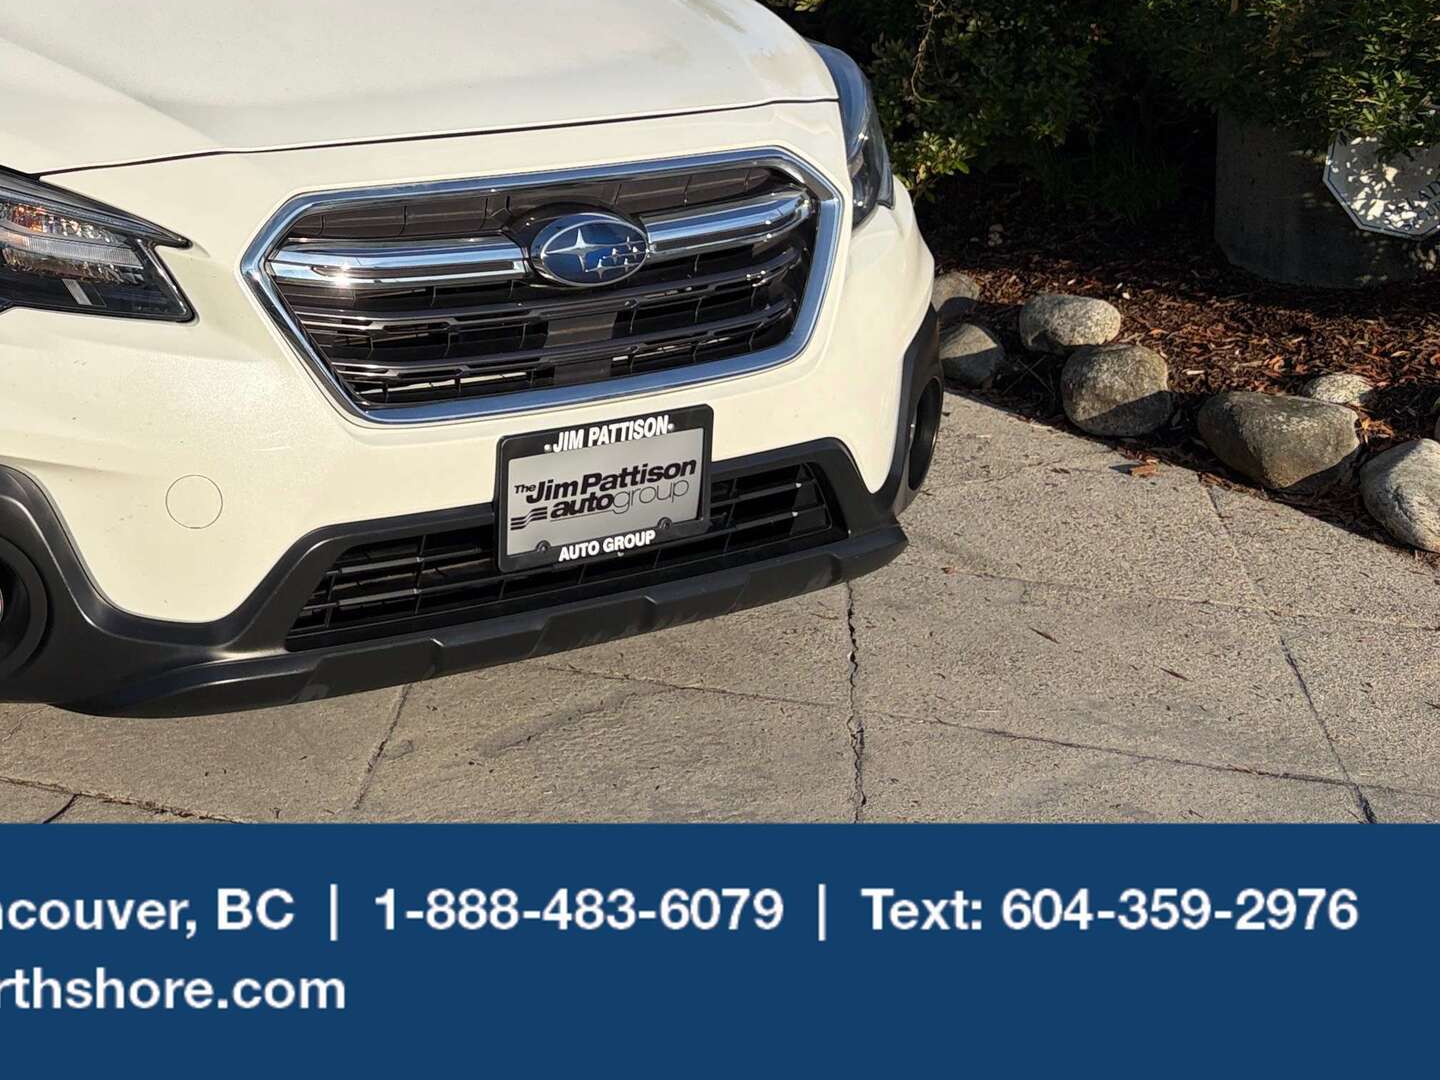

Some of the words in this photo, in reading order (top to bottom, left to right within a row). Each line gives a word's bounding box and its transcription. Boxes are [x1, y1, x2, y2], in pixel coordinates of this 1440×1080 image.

[553, 429, 584, 453] JIM
[588, 414, 670, 446] PATTISON
[514, 483, 536, 494] The
[526, 479, 578, 504] Jim
[581, 459, 697, 495] Pattison
[559, 544, 601, 562] AUTO
[603, 529, 656, 554] GROUP
